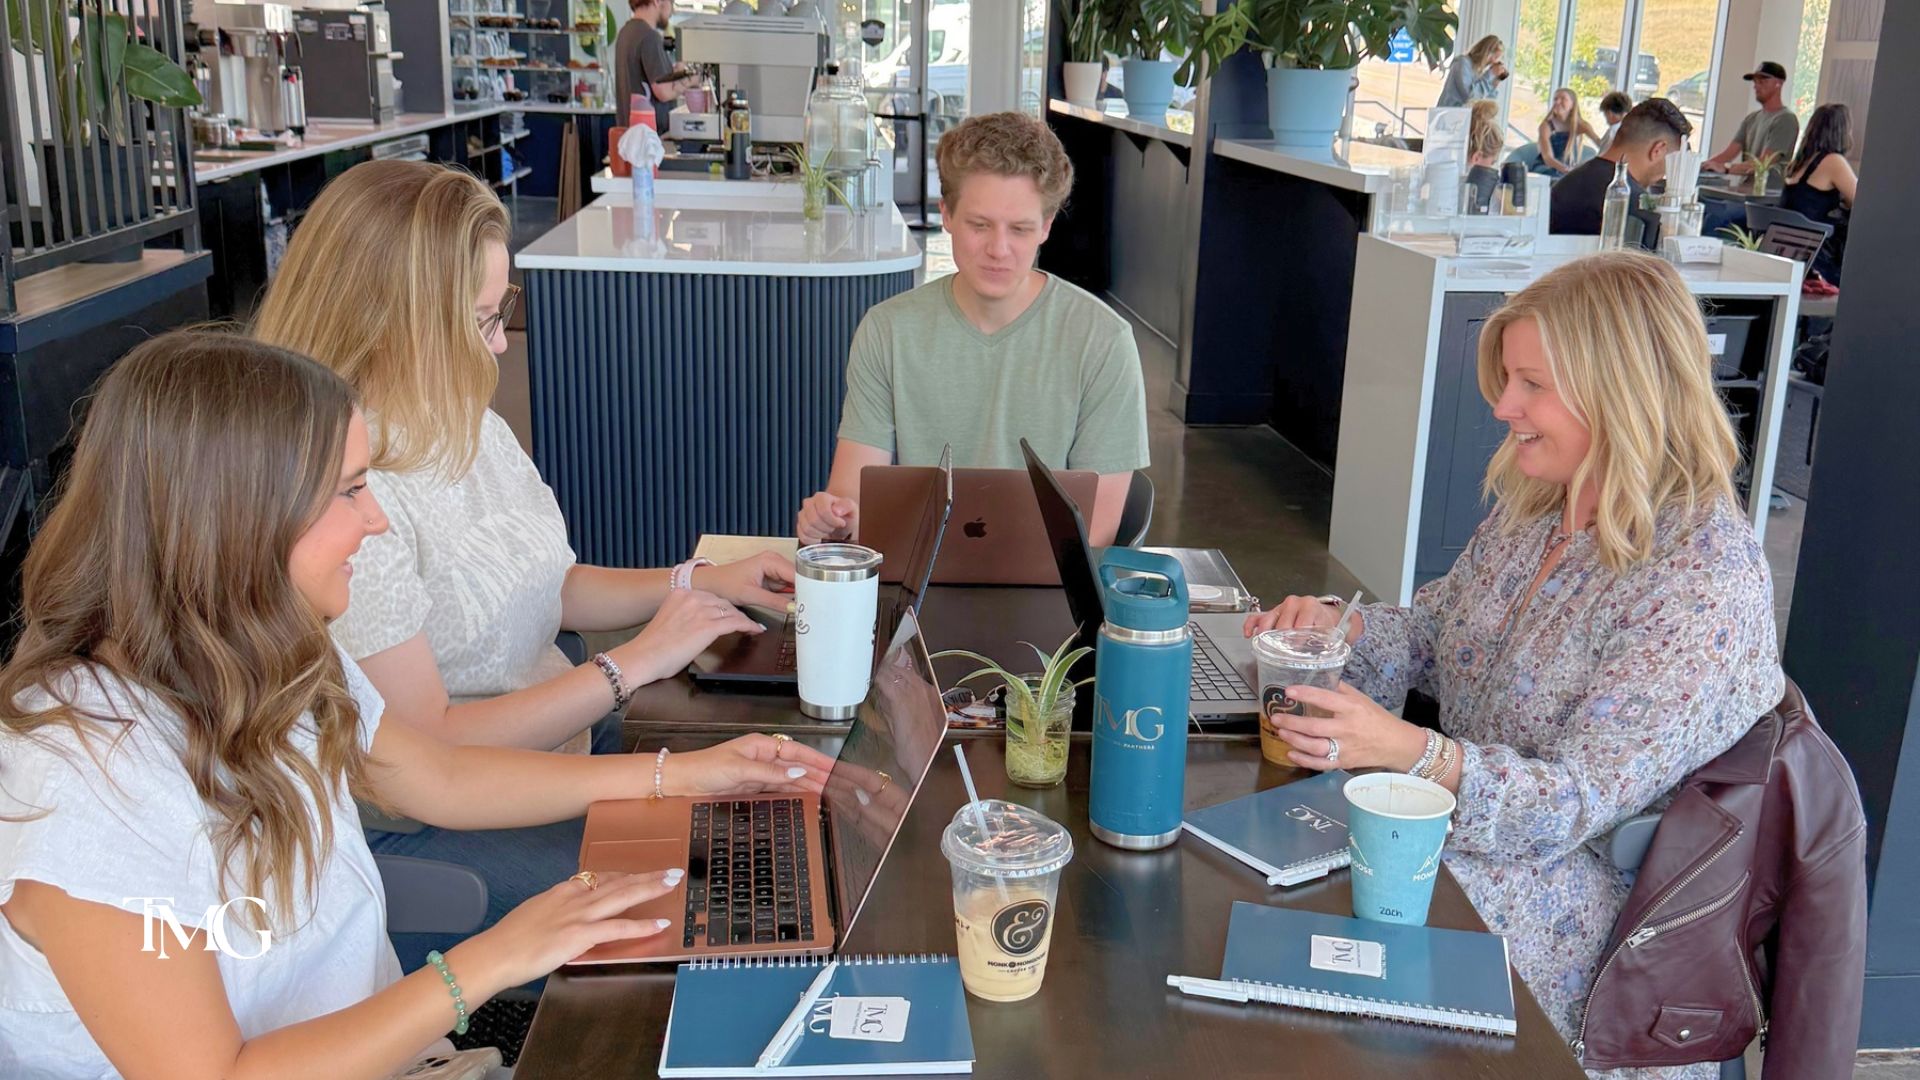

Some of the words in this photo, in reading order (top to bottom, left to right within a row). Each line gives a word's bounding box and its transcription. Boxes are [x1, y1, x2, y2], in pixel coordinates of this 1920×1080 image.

[1095, 692, 1165, 742] TMG
[1352, 858, 1375, 877] OOSE
[1378, 906, 1404, 918] Zach
[1331, 940, 1355, 965] TMG
[987, 960, 1008, 968] MONK
[859, 1003, 888, 1034] TMG
